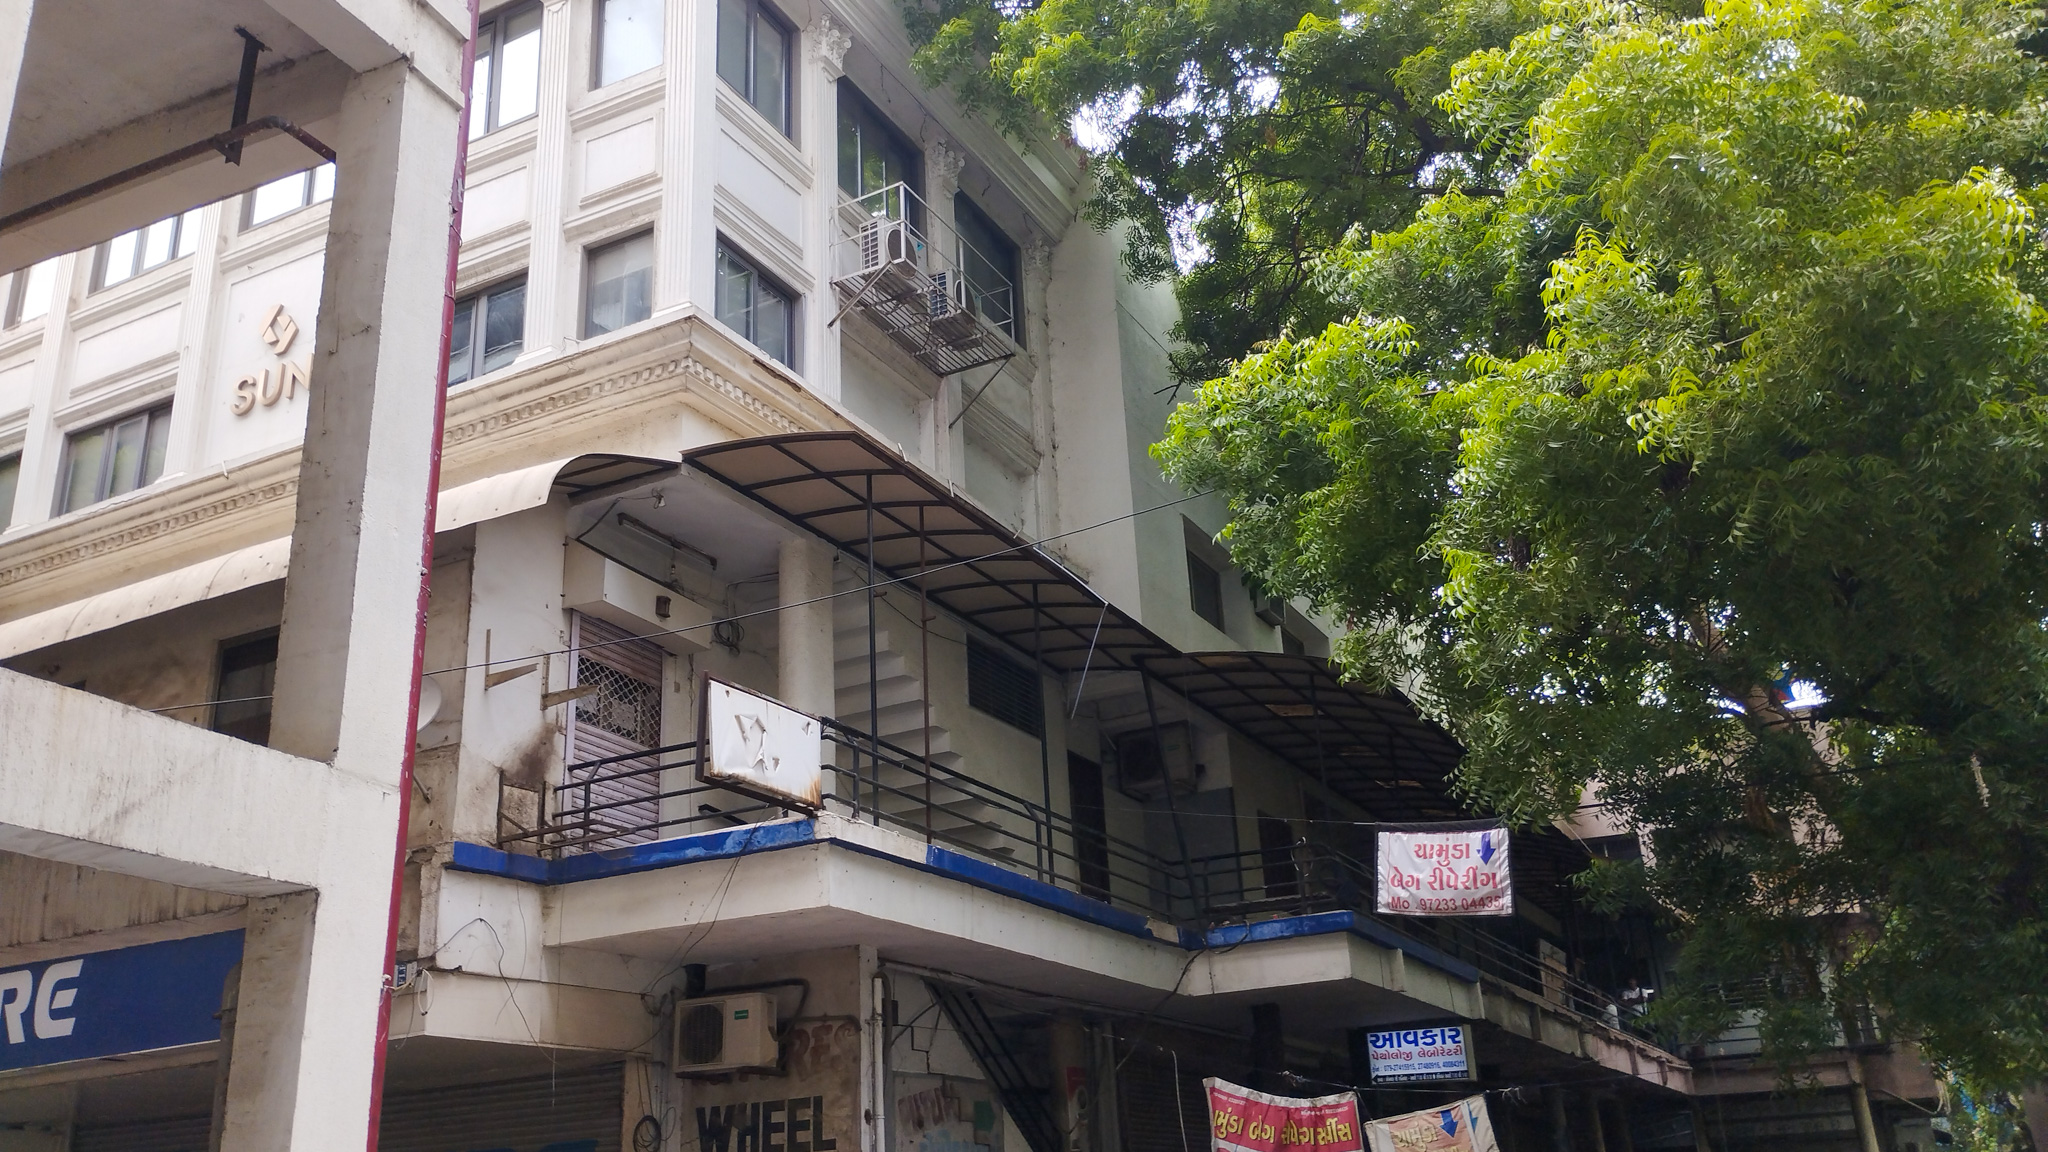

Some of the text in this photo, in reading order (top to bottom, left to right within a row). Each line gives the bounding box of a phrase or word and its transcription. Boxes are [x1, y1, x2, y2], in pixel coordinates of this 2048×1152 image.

[230, 353, 314, 416] SUN
[1414, 837, 1470, 867] ચામુંડા
[1390, 866, 1421, 890] બેગ
[1461, 896, 1502, 910] 04435
[1369, 1027, 1462, 1049] આવકાર
[696, 1096, 837, 1152] WHEEL
